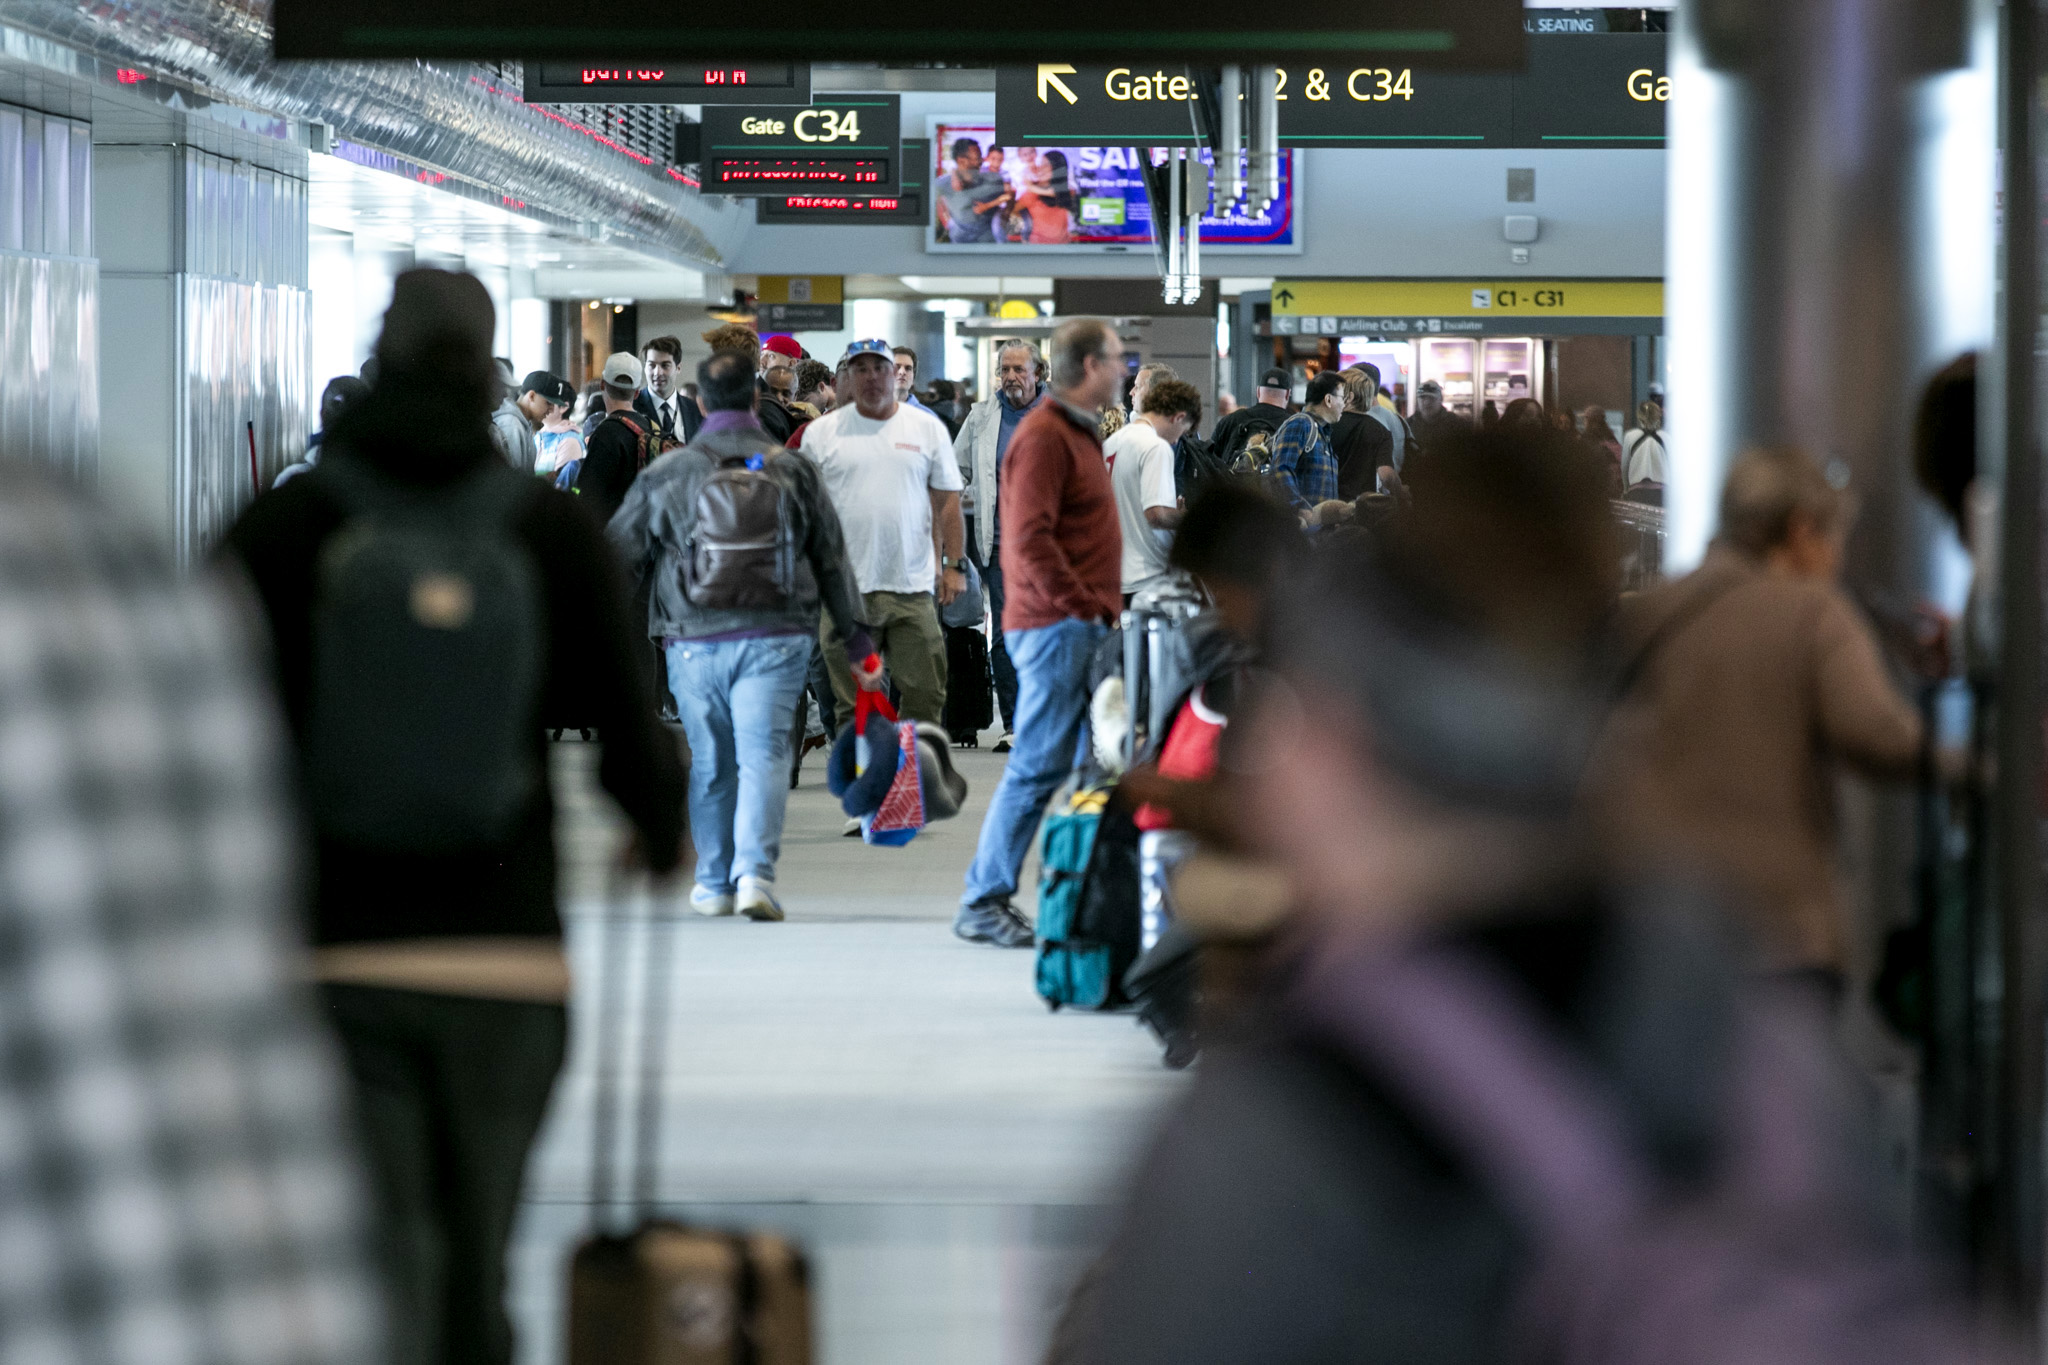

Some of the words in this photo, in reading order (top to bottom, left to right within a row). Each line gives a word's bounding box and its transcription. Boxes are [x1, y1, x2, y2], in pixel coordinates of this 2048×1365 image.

[1538, 18, 1594, 32] SEATING
[1305, 68, 1331, 101] &
[1347, 68, 1414, 101] C34
[741, 117, 786, 135] Gate
[793, 110, 861, 142] C34
[1497, 290, 1516, 307] C1
[1534, 290, 1564, 307] C31
[1340, 319, 1379, 331] Airline
[1380, 318, 1407, 332] Club
